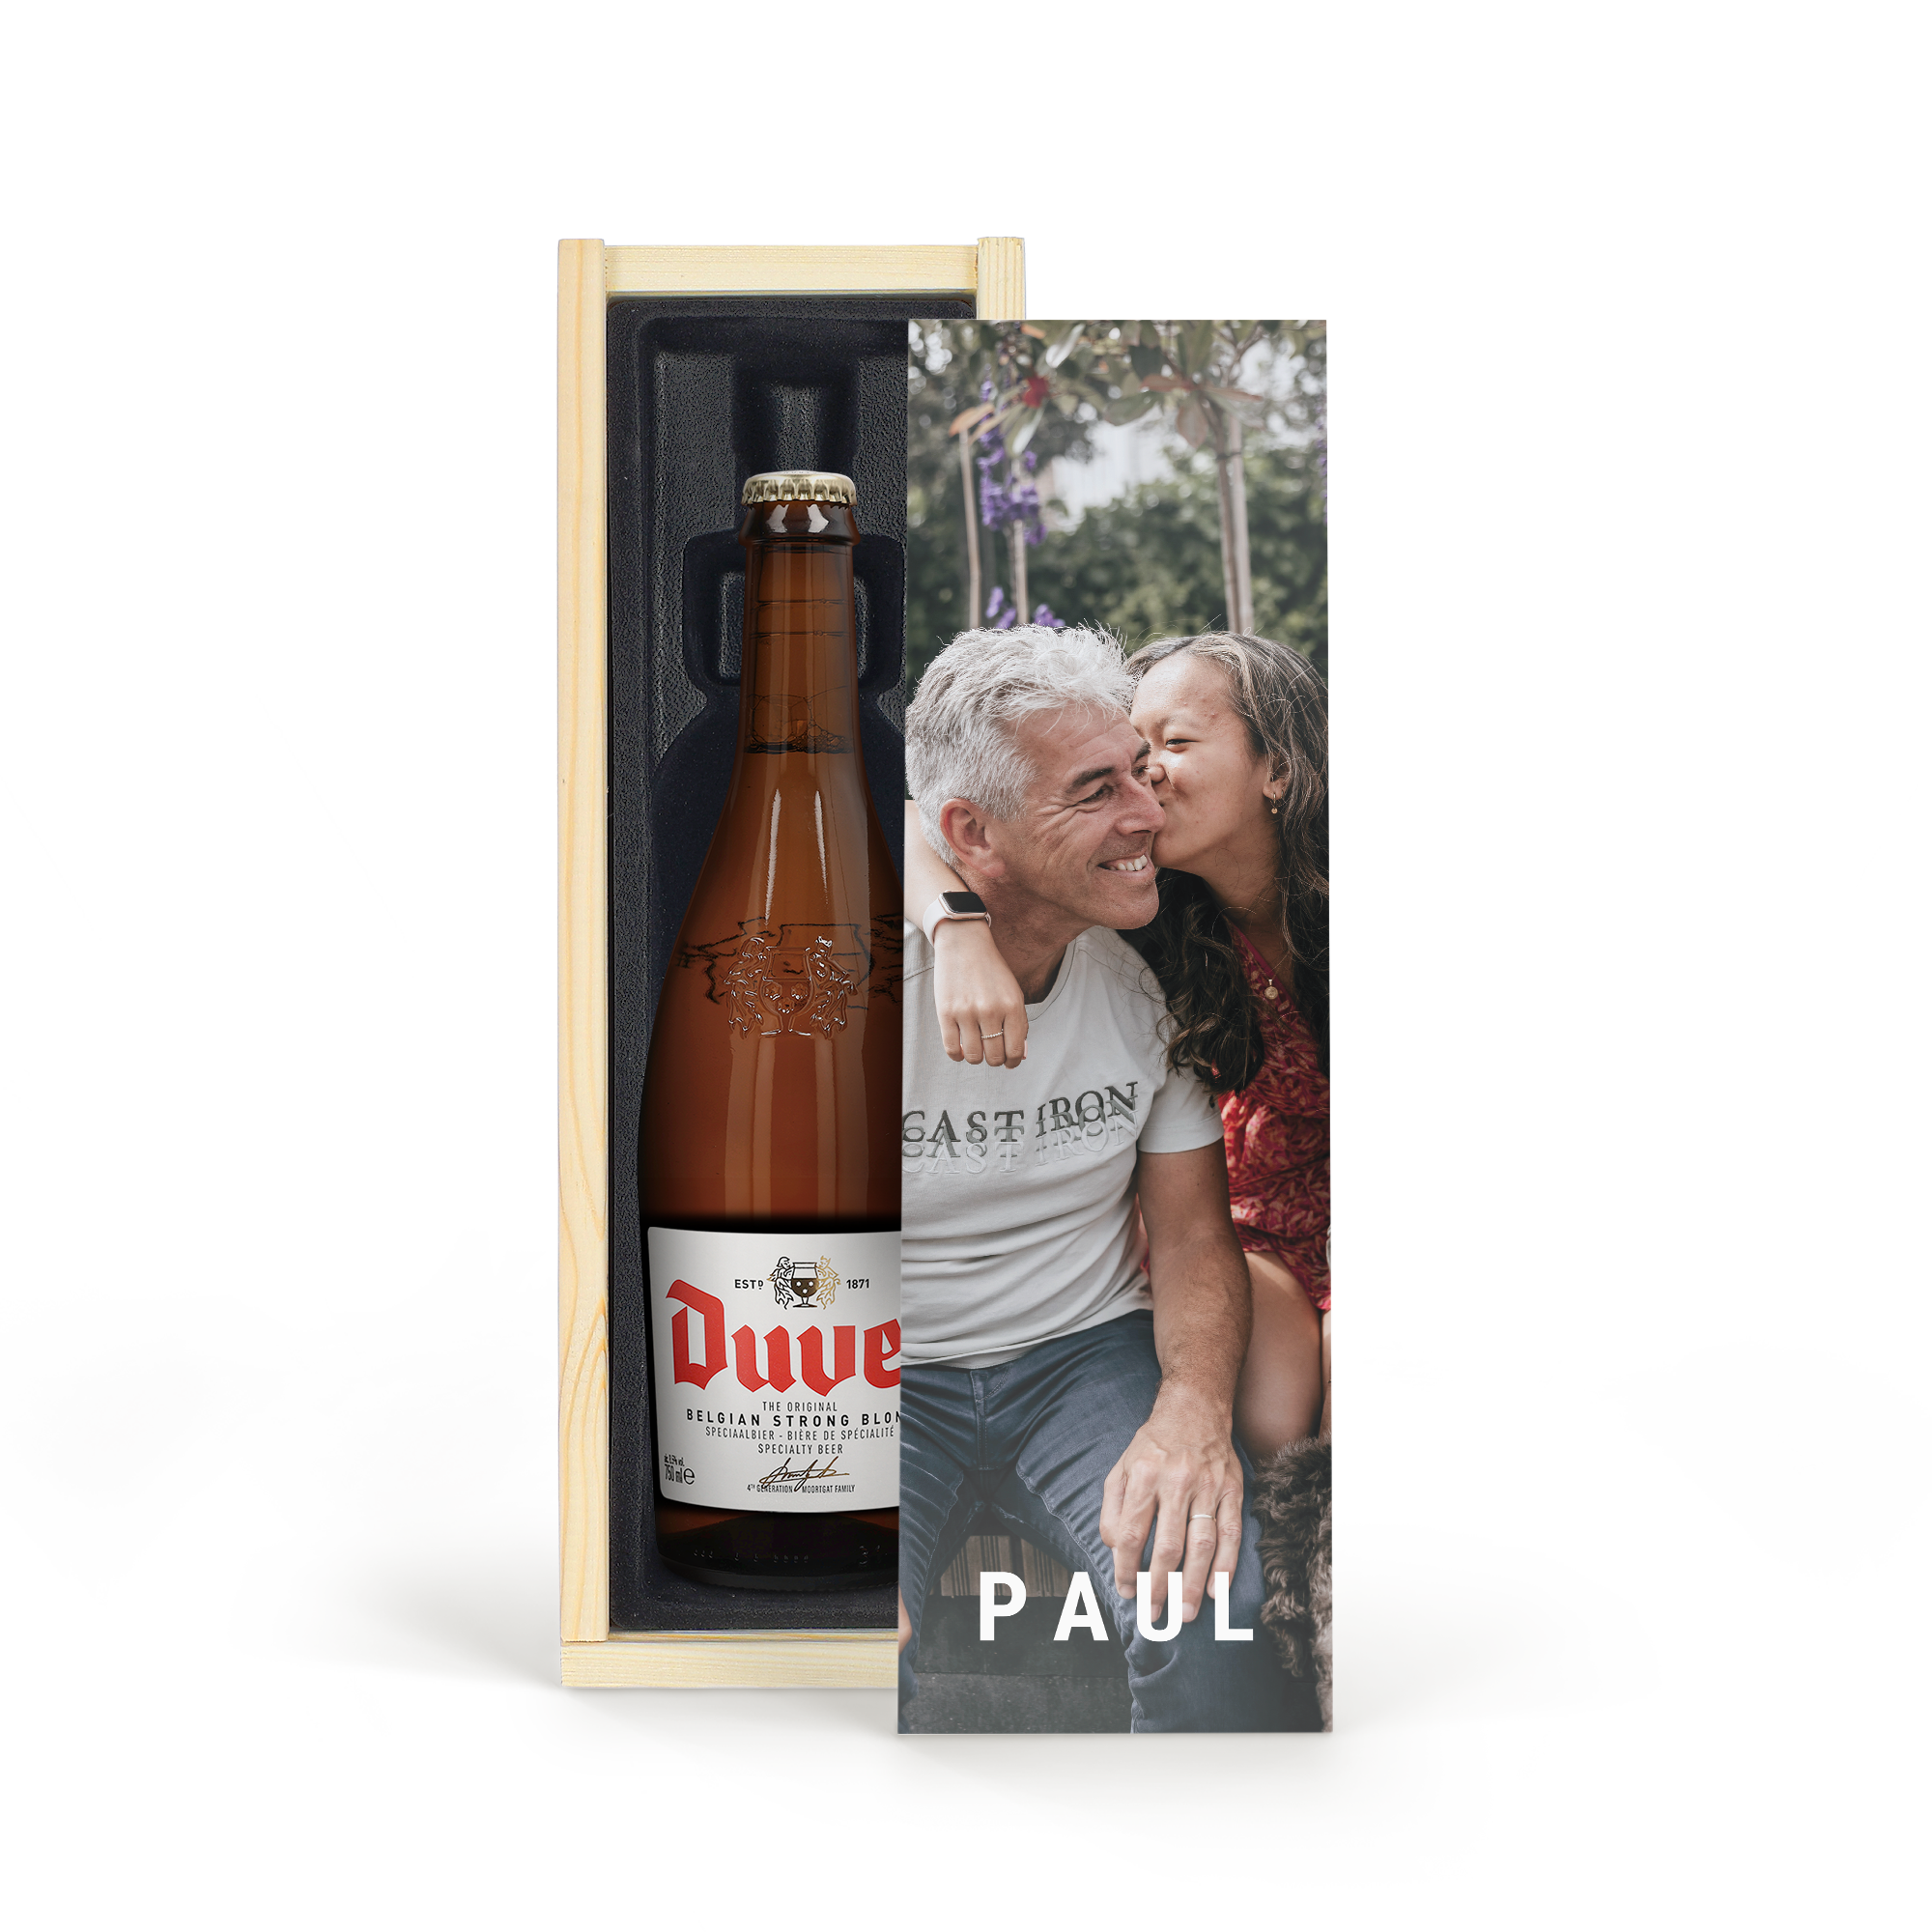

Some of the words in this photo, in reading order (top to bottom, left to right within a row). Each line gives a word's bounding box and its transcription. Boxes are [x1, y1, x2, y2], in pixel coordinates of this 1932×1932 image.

[902, 1109, 1024, 1143] CAST
[1036, 1081, 1139, 1139] IRON
[846, 1278, 870, 1290] 1871
[762, 1401, 781, 1412] THE
[787, 1401, 838, 1412] ORIGINAL
[686, 1408, 760, 1426] BELGIAN
[773, 1414, 850, 1427] STRONG
[705, 1426, 775, 1440] SPECIAALBIER
[787, 1428, 817, 1440] BIÈRE
[823, 1431, 836, 1440] DE
[840, 1425, 895, 1440] SPÉCIALITÉ
[757, 1443, 812, 1455] SPECIALTY
[817, 1443, 843, 1455] BEER
[756, 1485, 793, 1493] GENERATION
[802, 1485, 833, 1493] MOORTGAT
[835, 1485, 855, 1493] FAMILY
[980, 1571, 1254, 1642] PAUL
